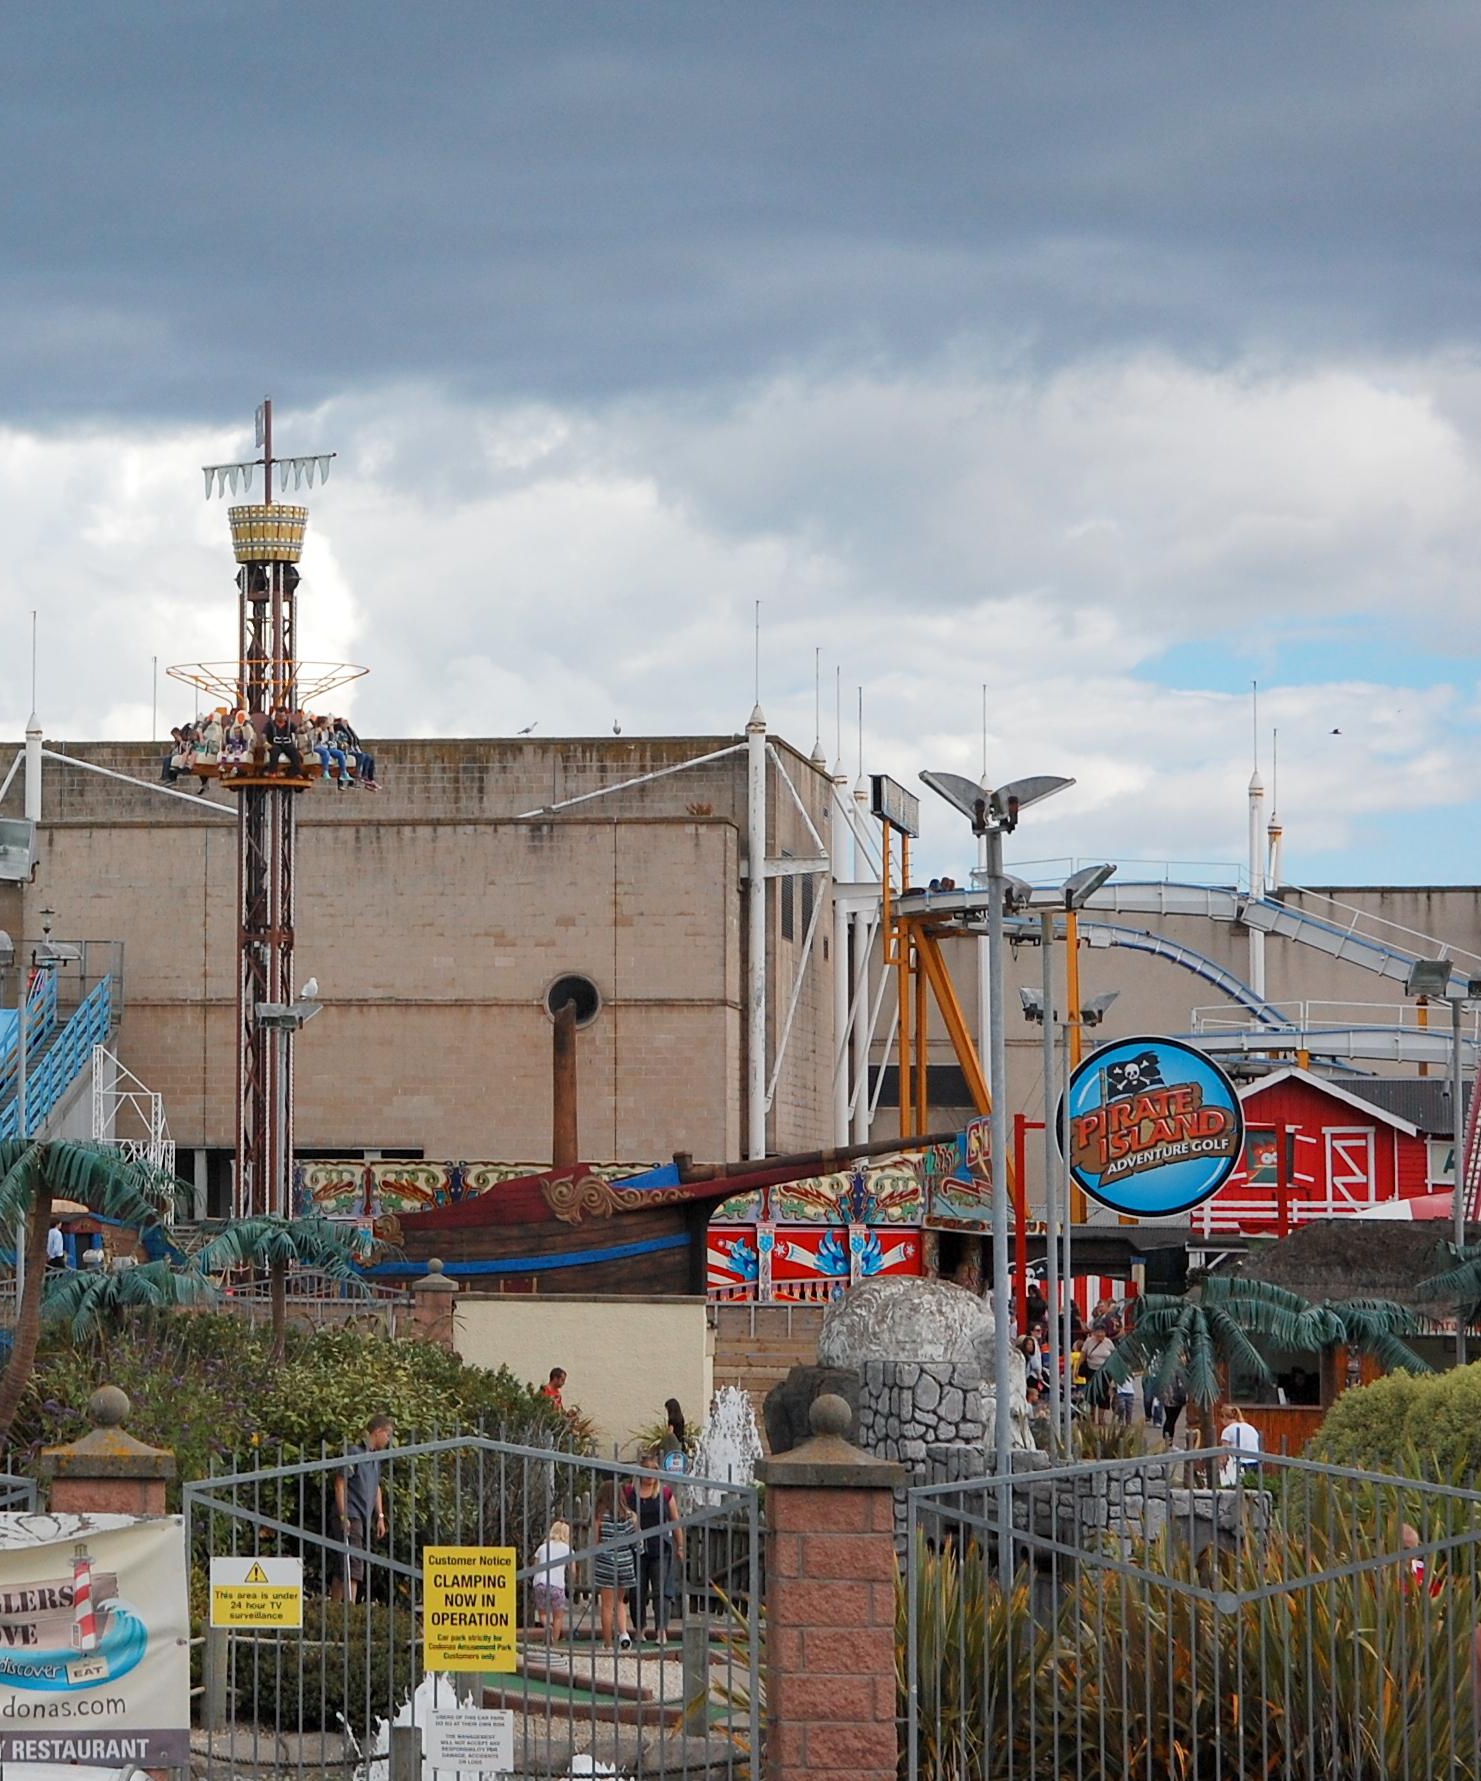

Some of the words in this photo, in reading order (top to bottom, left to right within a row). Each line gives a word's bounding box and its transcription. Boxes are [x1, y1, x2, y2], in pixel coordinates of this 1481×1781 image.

[1076, 1087, 1194, 1149] PIRATE
[1099, 1111, 1225, 1164] ISLAND
[1107, 1143, 1189, 1175] ADVENTURE
[1191, 1138, 1229, 1152] GOLF
[428, 1555, 476, 1566] Customer
[479, 1555, 512, 1566] Notice
[433, 1574, 506, 1589] CLAMPING
[215, 1591, 233, 1600] This
[237, 1592, 257, 1600] area
[261, 1591, 269, 1600] is
[272, 1591, 298, 1600] under
[444, 1593, 477, 1607] NOW
[481, 1593, 496, 1607] IN
[230, 1601, 242, 1610] 24
[246, 1601, 265, 1609] hour
[270, 1601, 282, 1609] TV
[229, 1611, 284, 1620] surveillance
[431, 1612, 509, 1627] OPERATION
[73, 1666, 103, 1678] EAT
[12, 1738, 149, 1760] RESTAURANT
